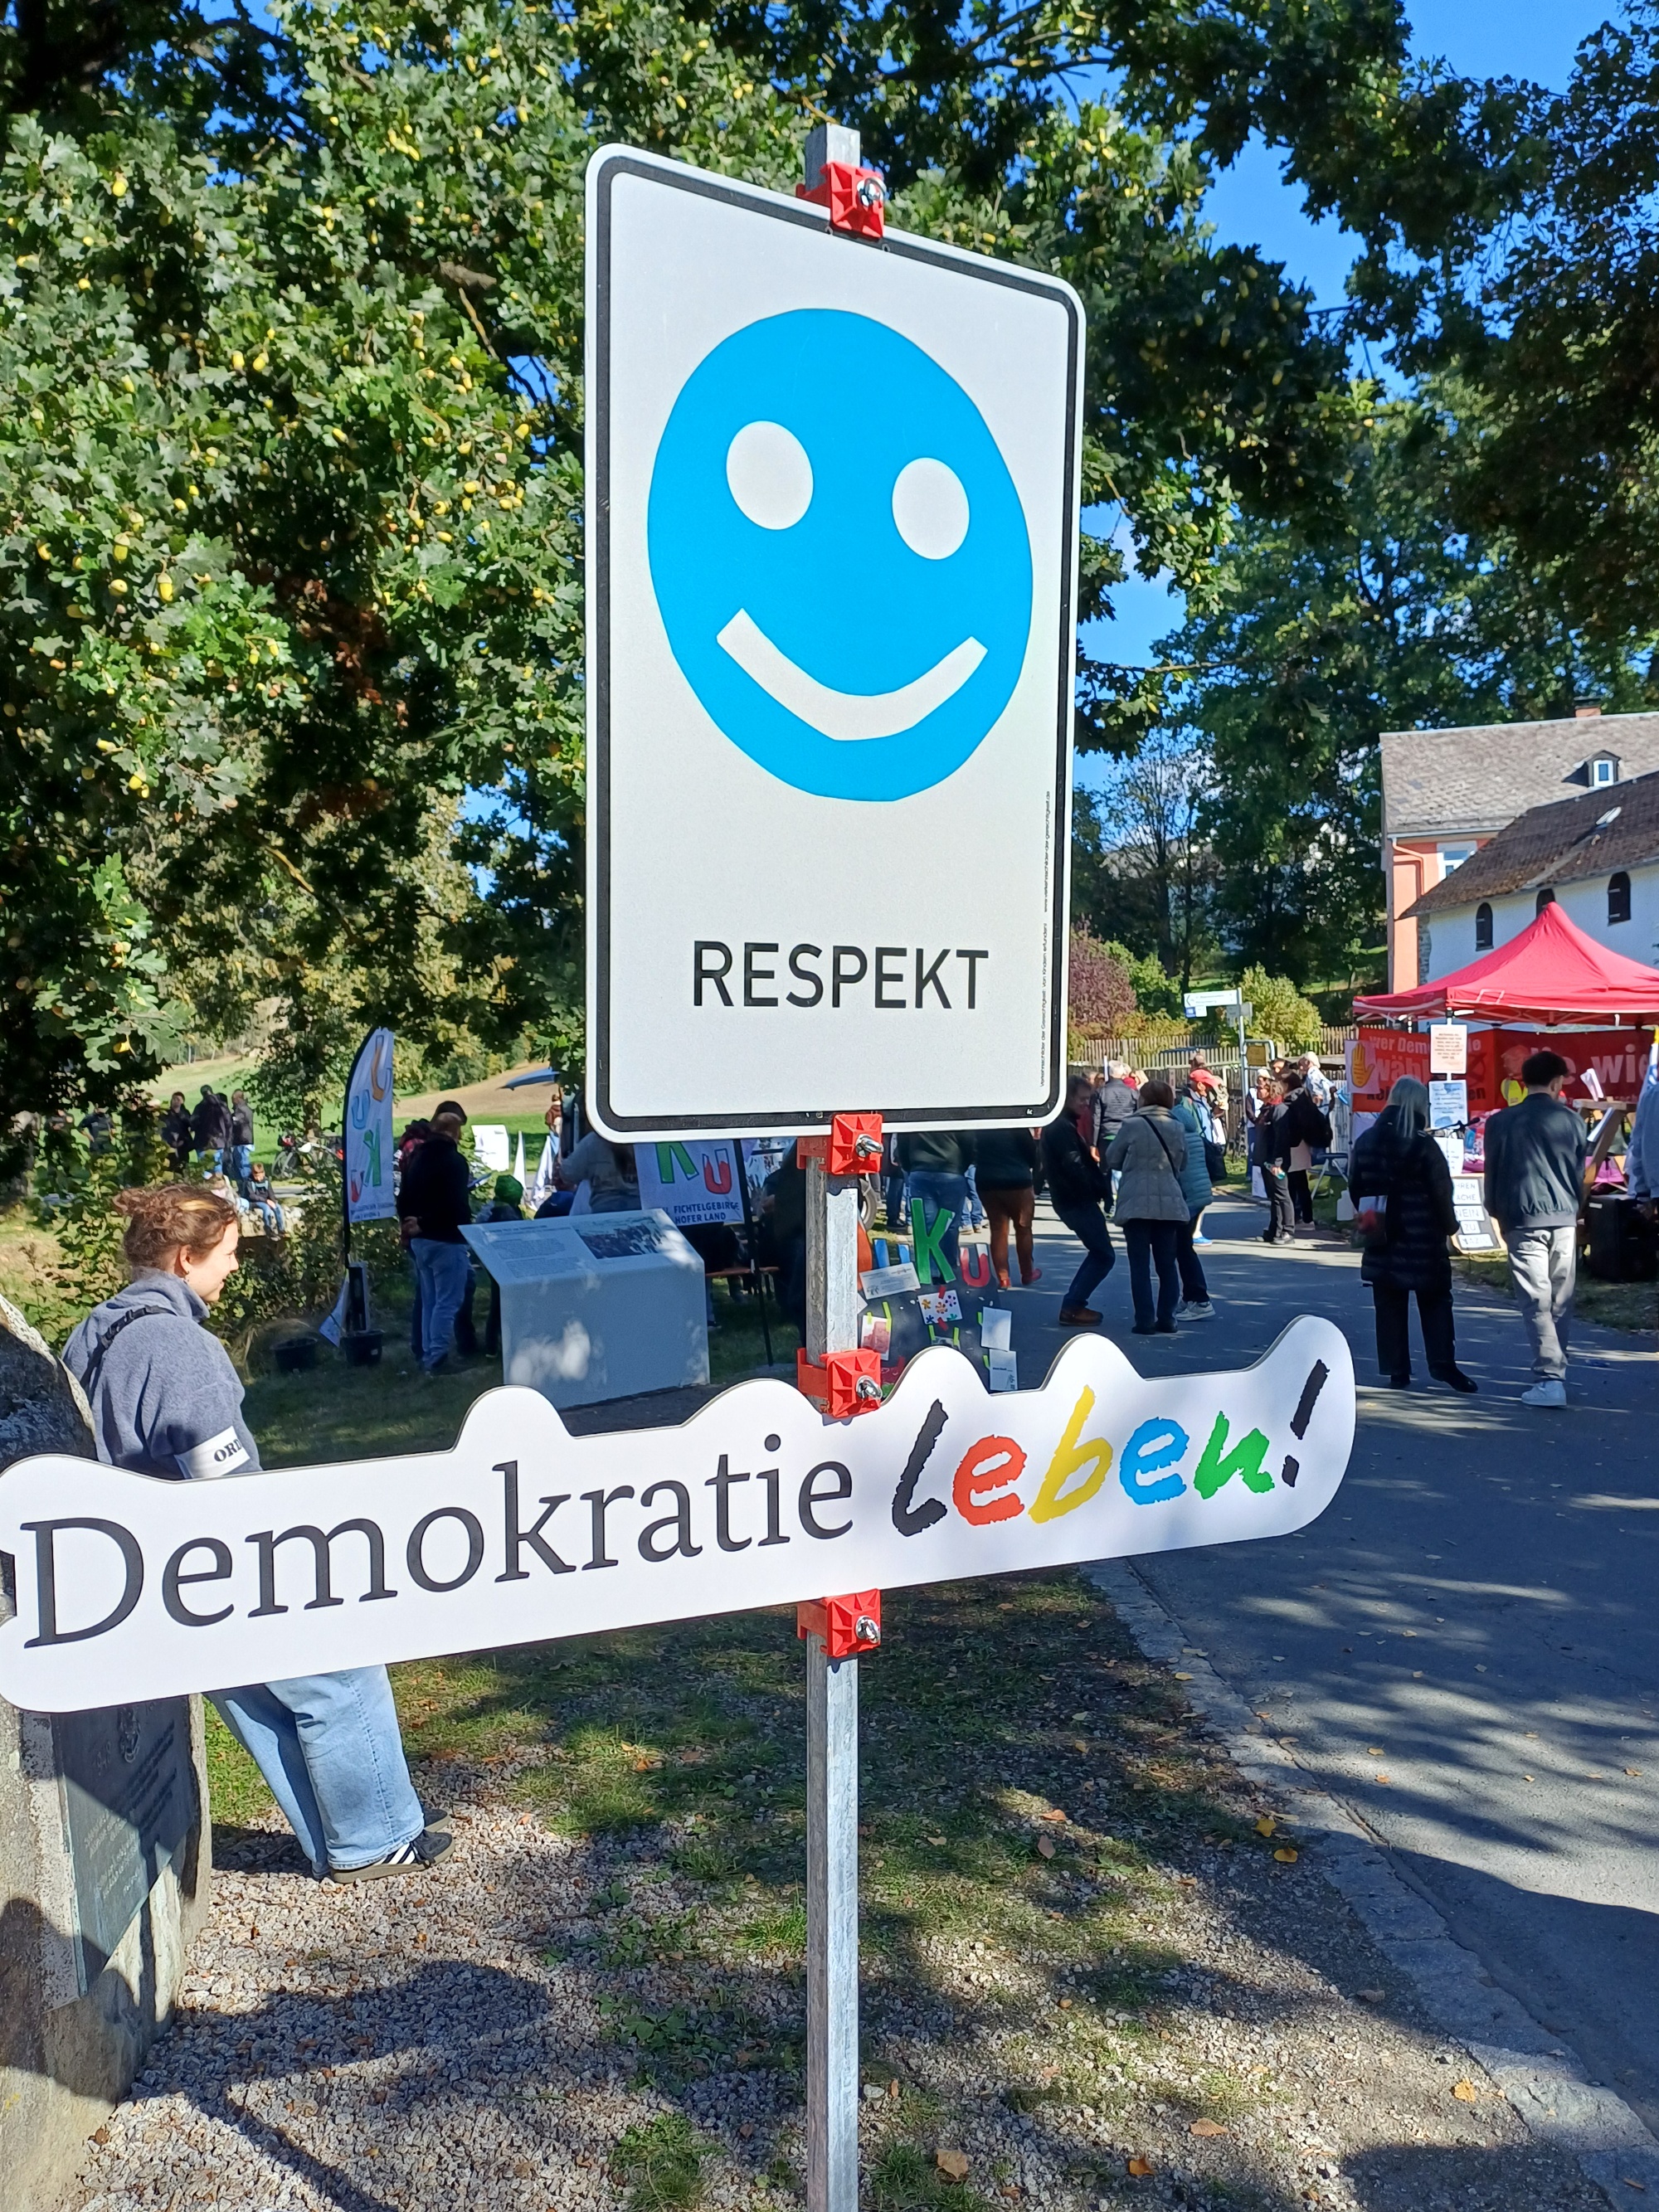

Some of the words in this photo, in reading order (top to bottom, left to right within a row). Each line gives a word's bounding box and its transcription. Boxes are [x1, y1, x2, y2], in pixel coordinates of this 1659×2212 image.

[693, 941, 989, 1009] RESPEKT
[674, 1202, 740, 1214] FICHTELGEBIRGE
[675, 1213, 702, 1224] HOFER
[704, 1212, 727, 1221] LAND
[21, 1433, 854, 1649] Demokratie
